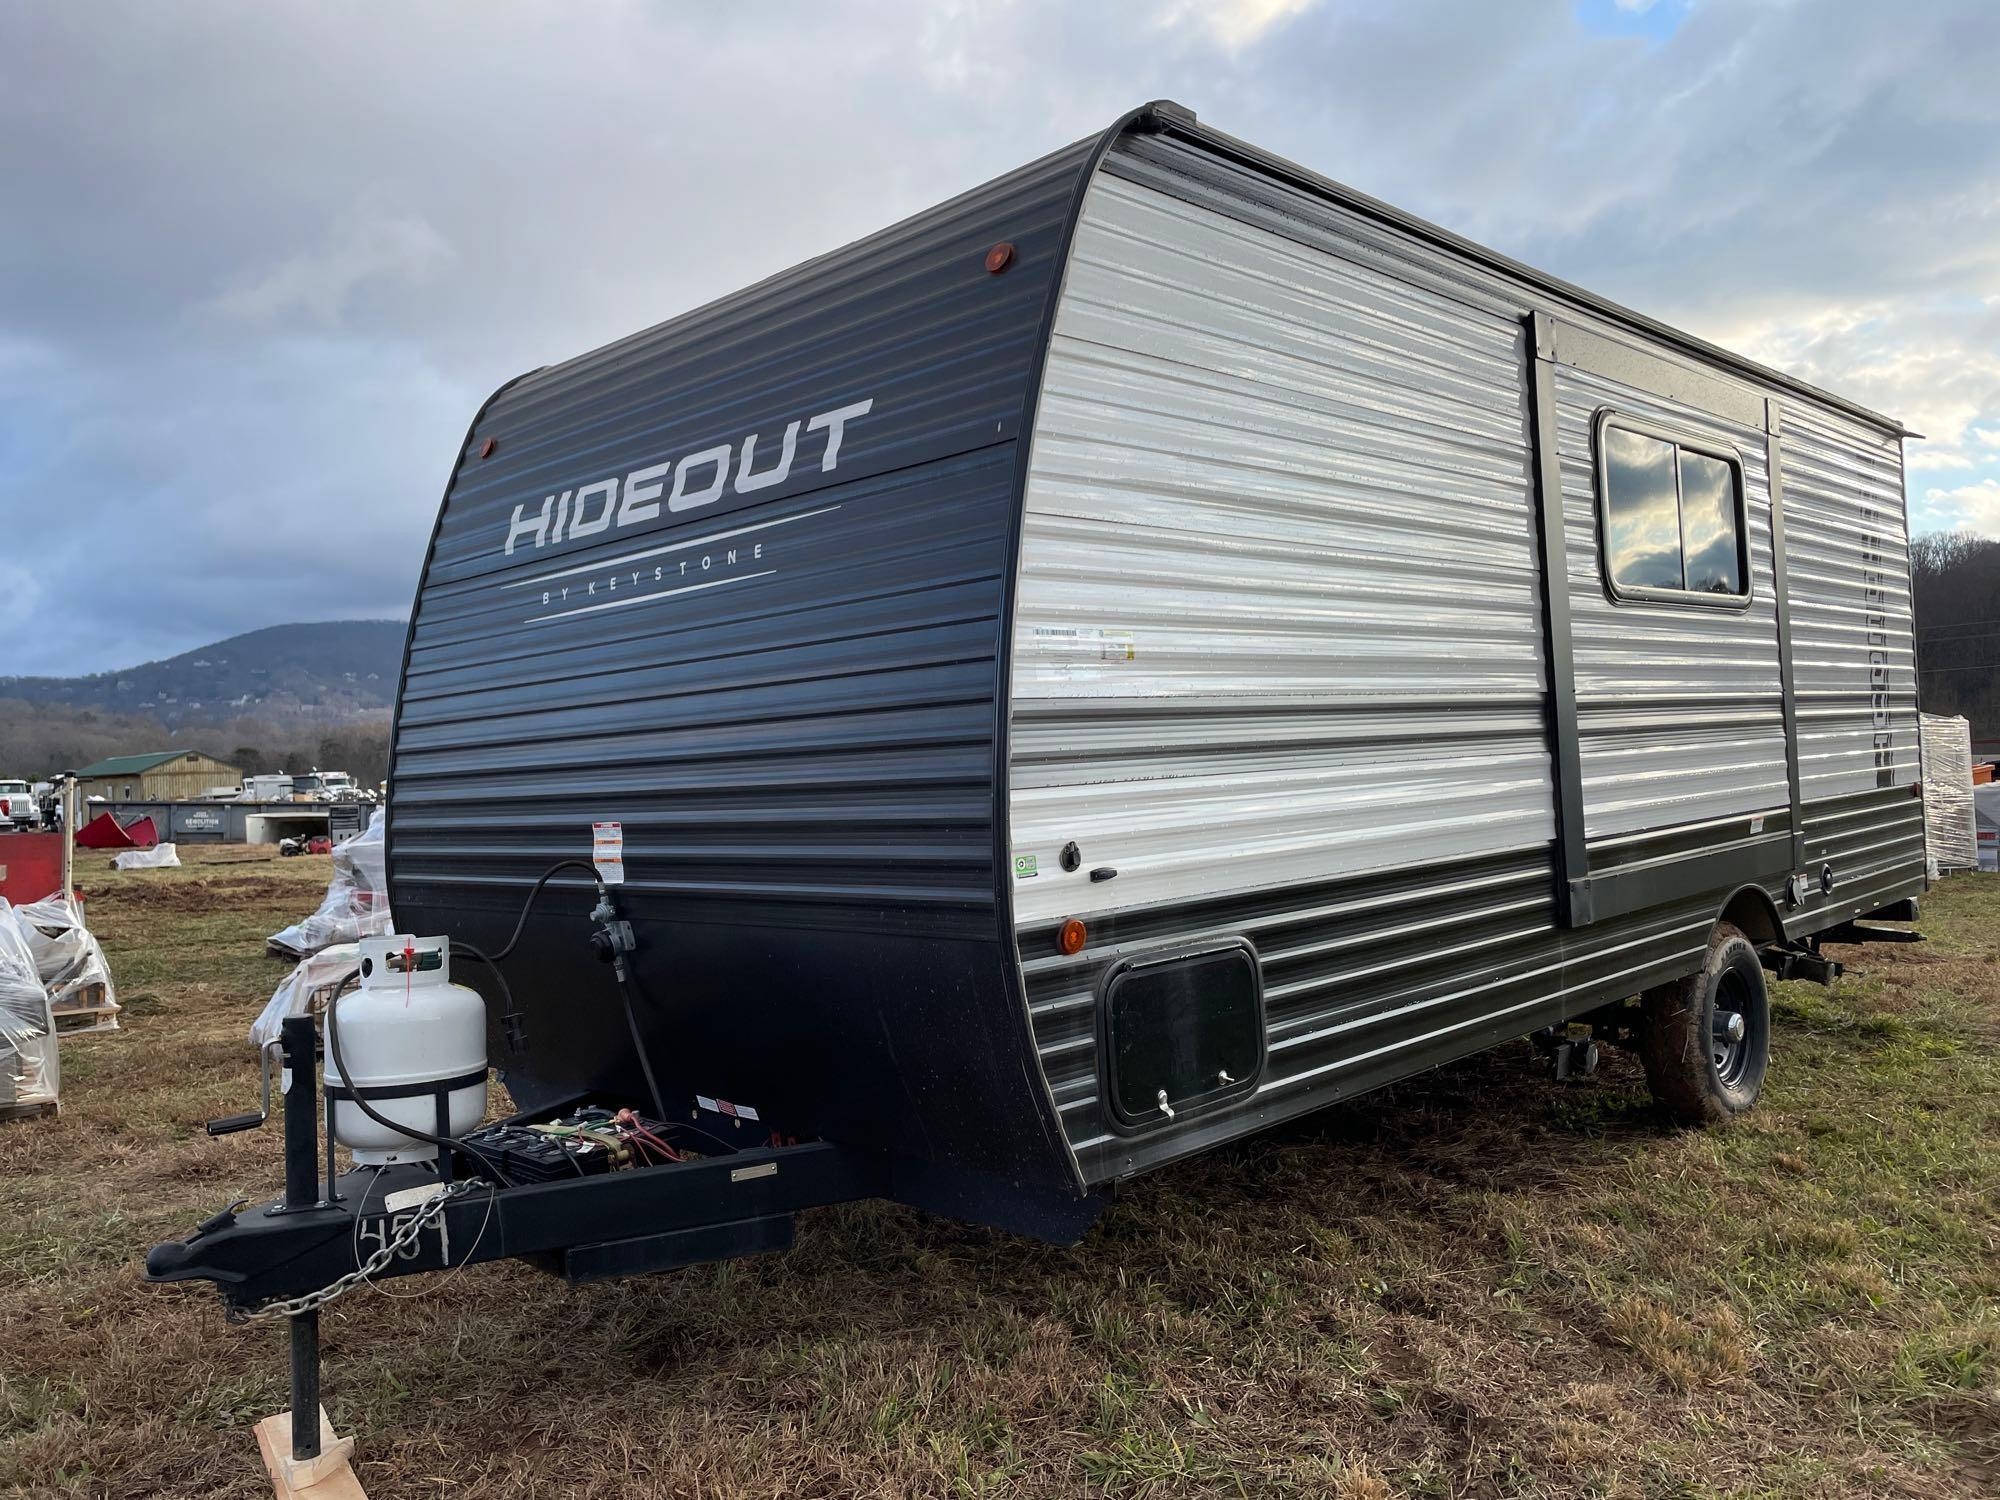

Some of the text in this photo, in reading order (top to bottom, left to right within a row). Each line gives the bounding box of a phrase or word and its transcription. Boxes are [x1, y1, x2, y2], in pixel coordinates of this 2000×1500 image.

[504, 398, 874, 556] HIDEOUT
[542, 543, 762, 605] BY KEYSTONE
[360, 1209, 449, 1266] 459
